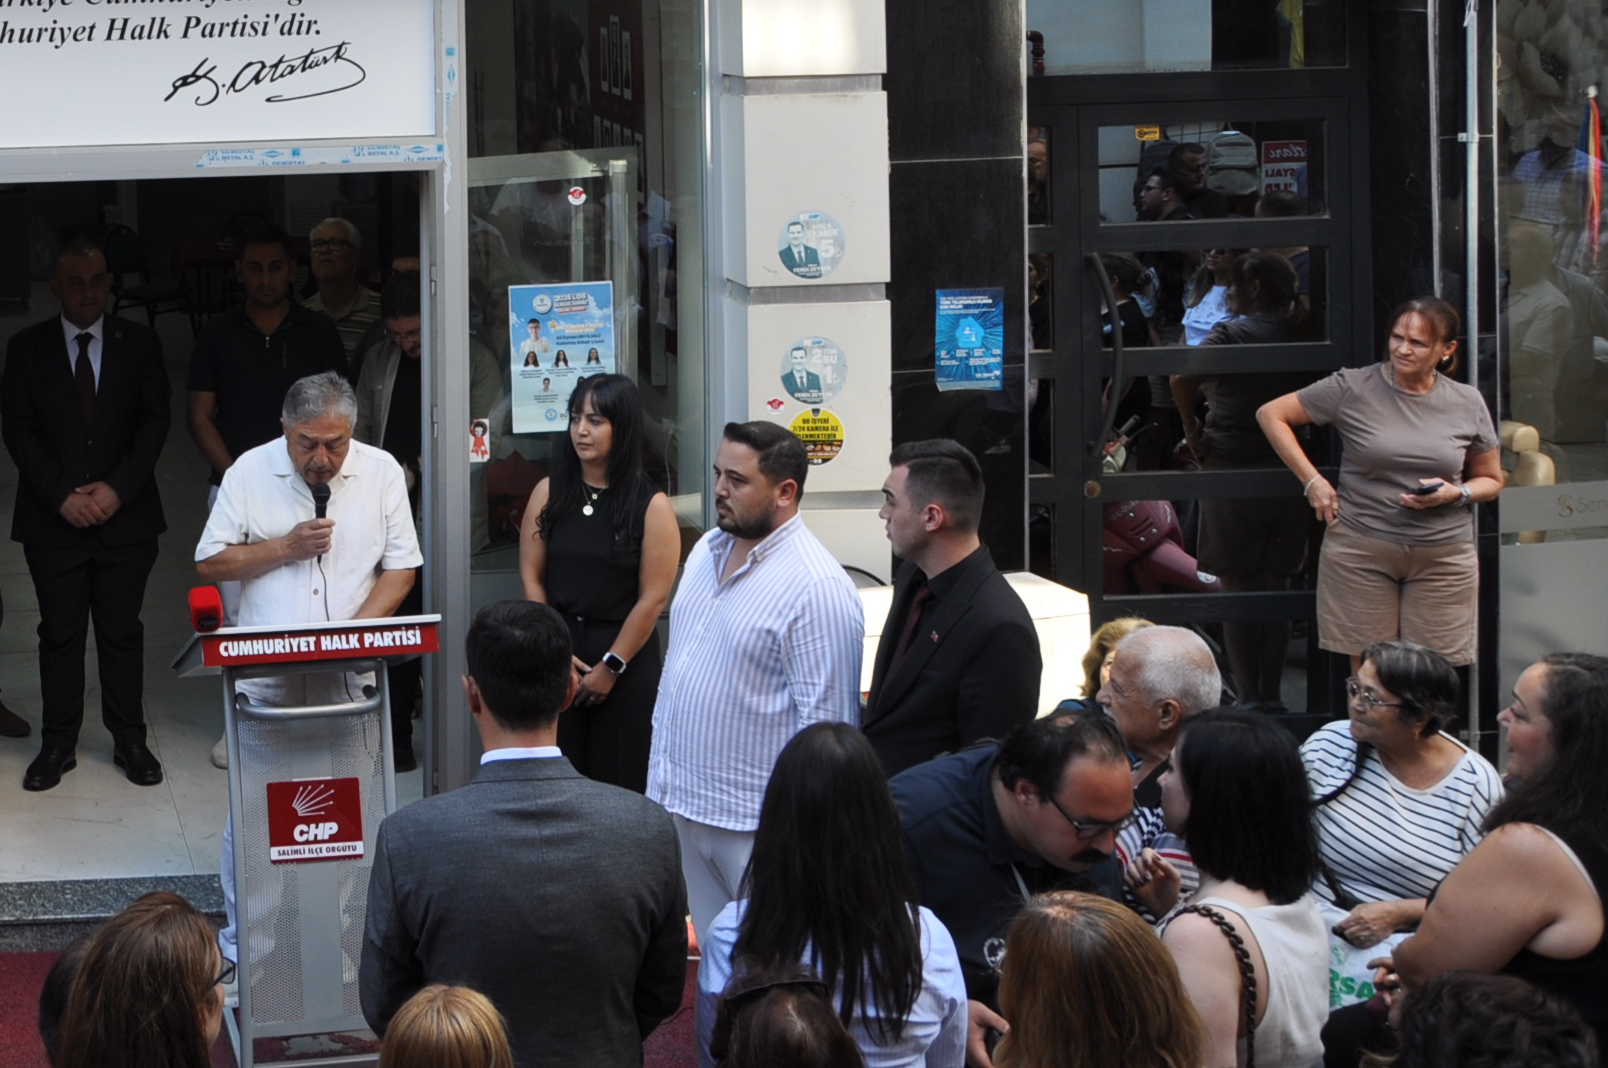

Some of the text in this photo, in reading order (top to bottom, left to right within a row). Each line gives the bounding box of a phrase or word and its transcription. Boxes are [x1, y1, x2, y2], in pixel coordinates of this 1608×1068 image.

[104, 14, 172, 43] Halk
[182, 13, 321, 42] Partisi'dir.
[219, 626, 422, 657] CUMHURİYET HALK PARTİSİ
[293, 821, 338, 842] CHP
[277, 846, 305, 857] SALİHLİ
[308, 845, 323, 856] İLÇE
